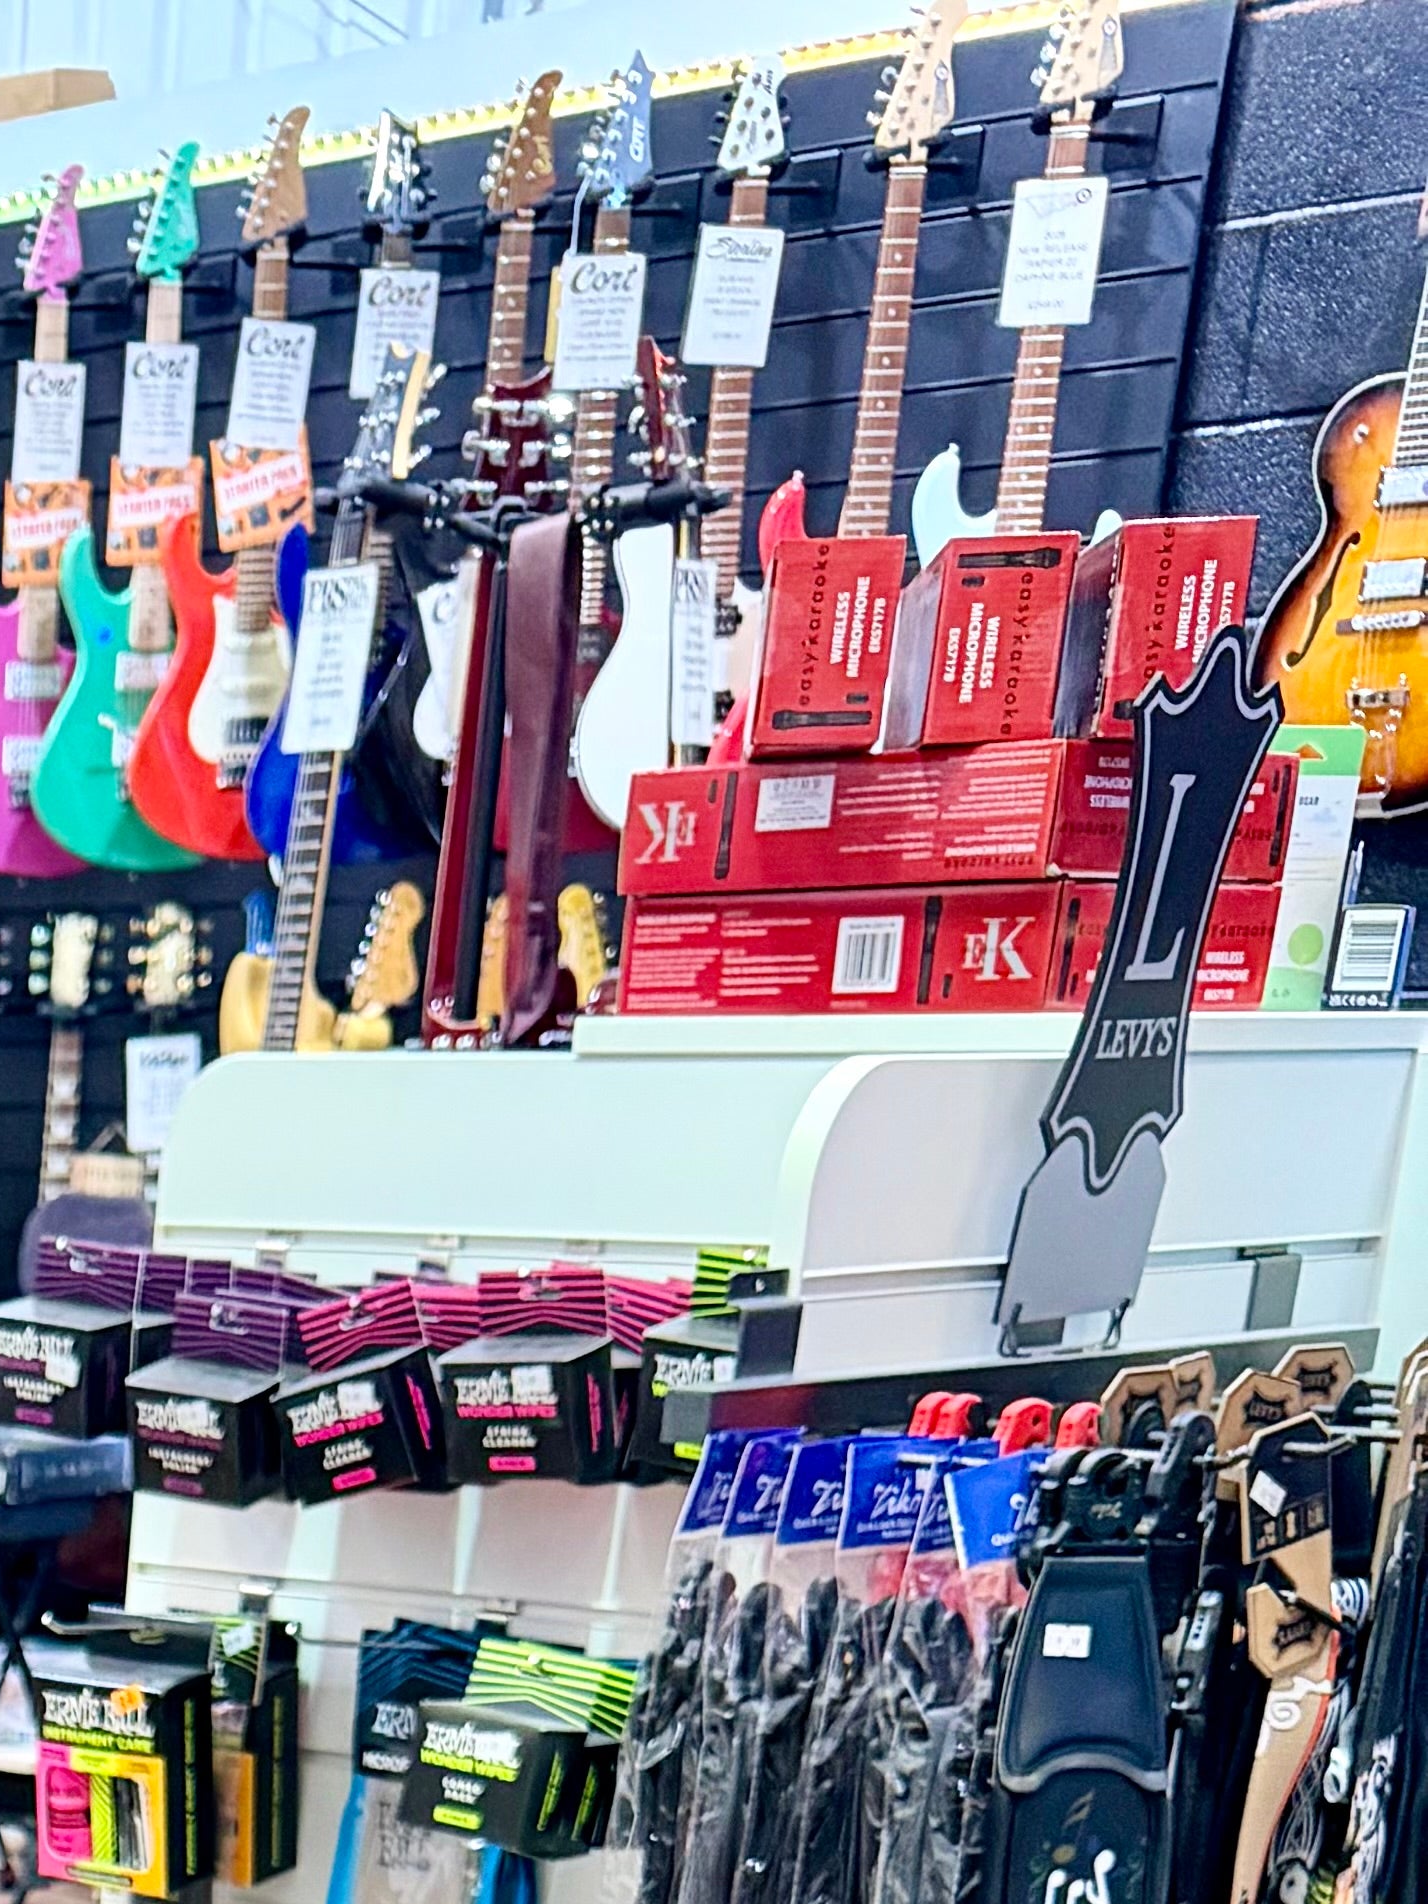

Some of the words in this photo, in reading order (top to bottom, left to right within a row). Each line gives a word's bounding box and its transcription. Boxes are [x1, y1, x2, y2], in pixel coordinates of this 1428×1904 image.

[368, 275, 432, 308] Cort
[569, 260, 639, 295] Cort
[246, 325, 306, 361] Cort
[829, 590, 851, 665] WIRELESS
[846, 575, 872, 679] MICROPHONE
[1174, 574, 1198, 651] WIRELESS
[958, 602, 985, 704] MICROPHONE
[980, 616, 1001, 690] WIRELESS
[1095, 1015, 1178, 1061] LEVY'S
[653, 1352, 712, 1390] ERNIE
[294, 1423, 346, 1448] WONDER
[346, 1410, 384, 1433] WIPES
[457, 1405, 513, 1419] WONDER
[514, 1404, 558, 1419] WIPES
[42, 1688, 100, 1729] ERNIE
[42, 1724, 116, 1750] INSTRUMENT
[117, 1736, 154, 1754] CARE
